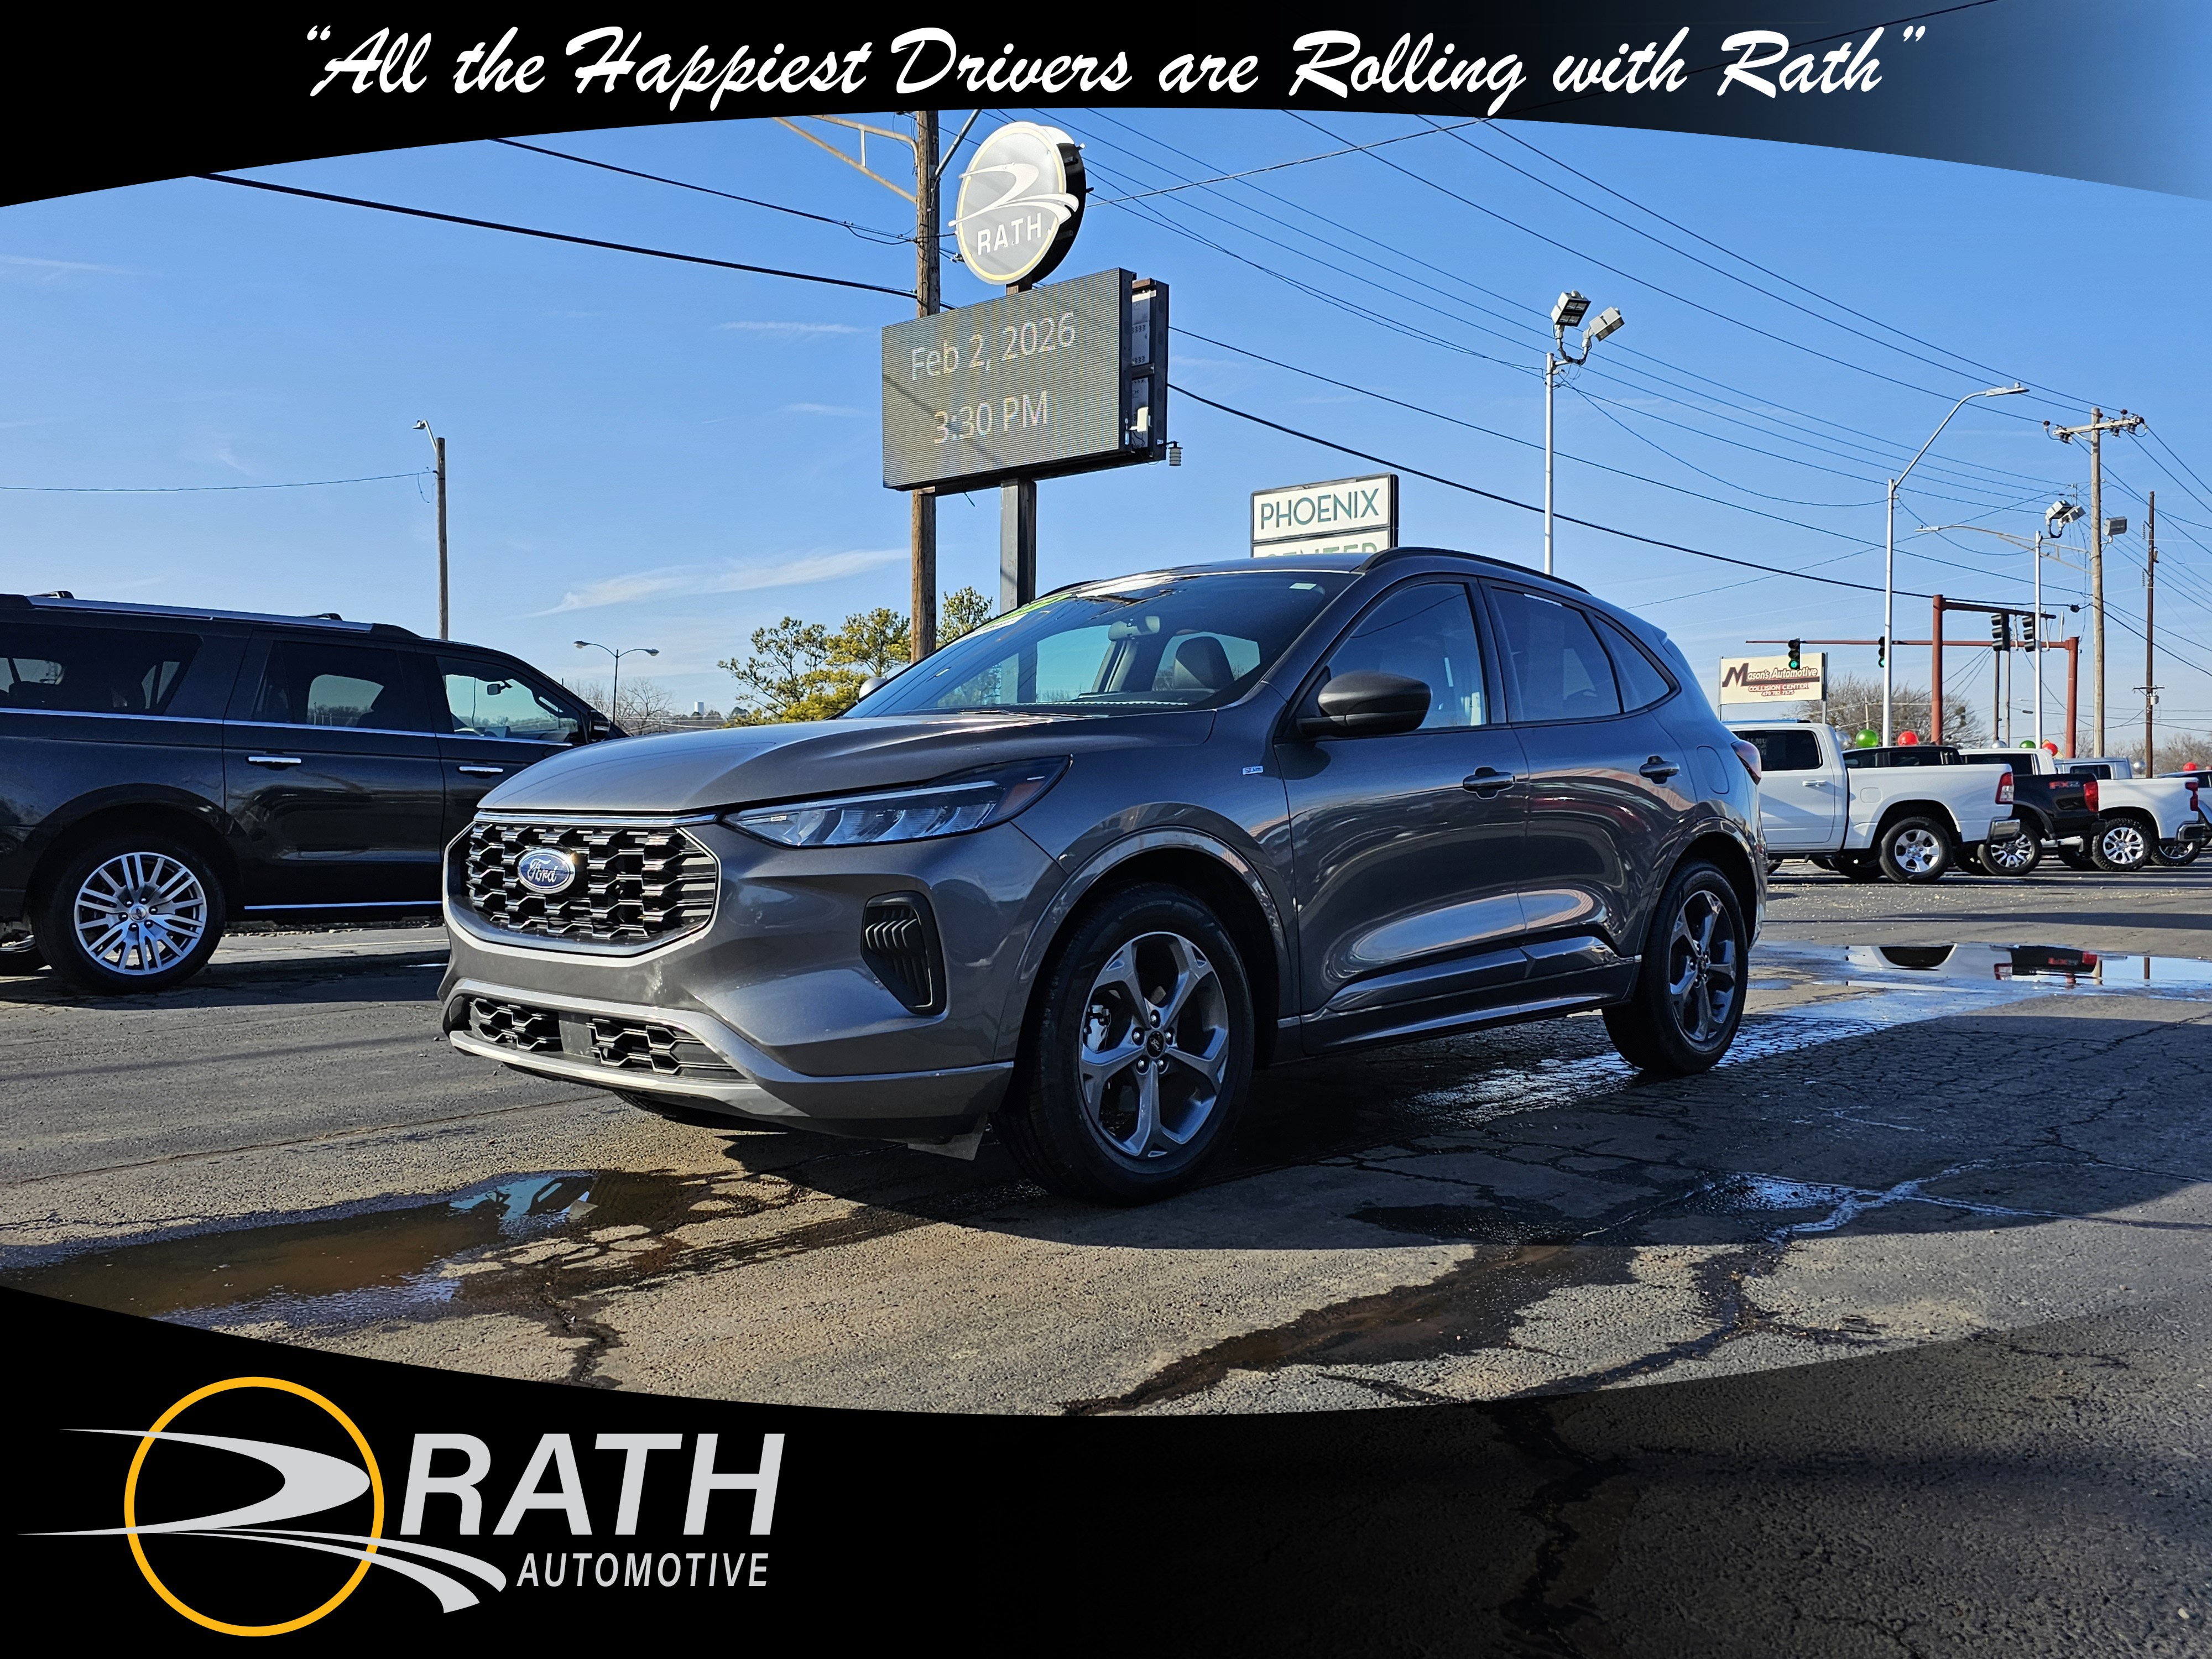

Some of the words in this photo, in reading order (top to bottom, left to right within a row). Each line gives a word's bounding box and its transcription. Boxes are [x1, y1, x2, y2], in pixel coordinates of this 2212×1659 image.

[977, 212, 1042, 255] RATH
[911, 339, 959, 382] Feb
[968, 333, 992, 372] 2,
[1001, 311, 1076, 361] 2026
[933, 401, 993, 445] 3:30
[1003, 390, 1047, 431] PM
[1261, 488, 1379, 530] PHOENIX
[1722, 662, 1770, 687] Mason's
[1771, 666, 1818, 679] Automotive
[1748, 684, 1781, 692] COLLISION
[527, 858, 559, 883] Ford
